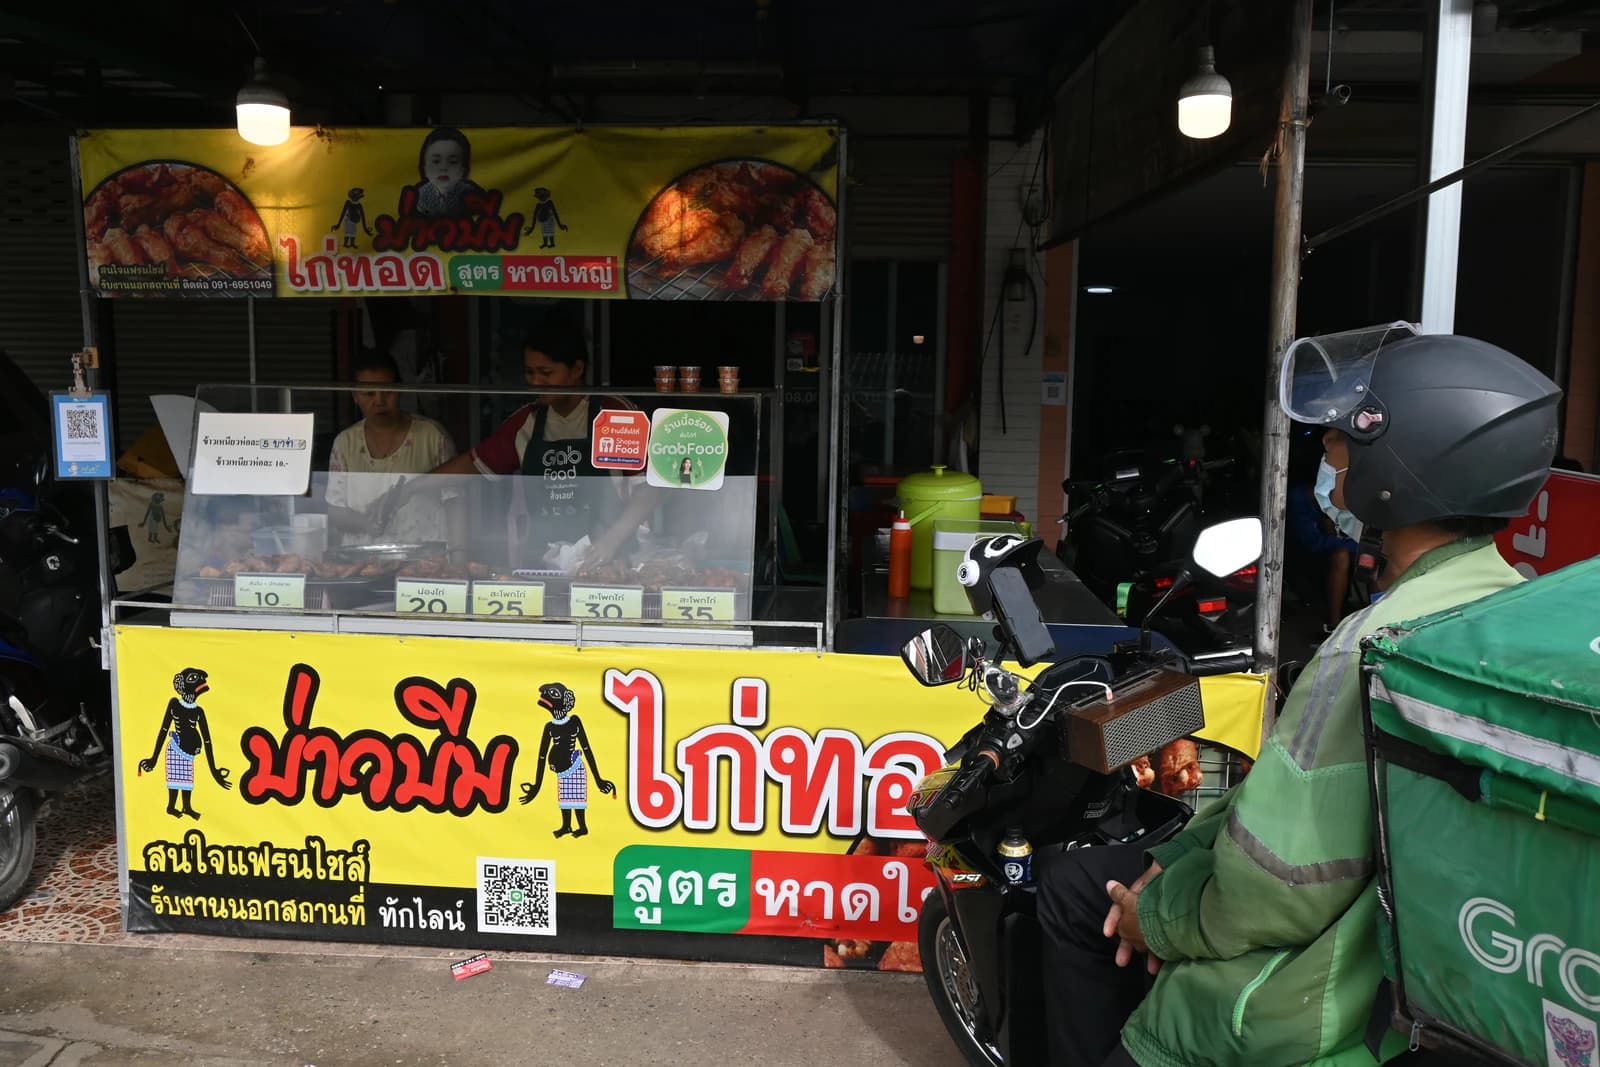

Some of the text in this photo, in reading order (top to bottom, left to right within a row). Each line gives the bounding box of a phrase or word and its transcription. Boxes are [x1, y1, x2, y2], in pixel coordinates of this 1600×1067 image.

[279, 235, 446, 291] ไก่ทอด
[456, 256, 614, 290] สูตร หาดใหญ่
[100, 278, 272, 290] รับงานนอกสถานที่ ติดต่อ 091-6951049
[663, 414, 713, 434] ร้านนี้อร่อย
[262, 439, 269, 448] 5
[615, 437, 640, 447] Shopee
[615, 445, 640, 454] Food
[651, 442, 725, 455] GrabFood
[543, 465, 577, 481] Food
[254, 591, 280, 606] 10
[417, 587, 445, 596] น่องไก่
[490, 589, 526, 599] สะโพกไก่
[588, 592, 624, 602] สะโพกไก่
[408, 597, 448, 614] 20
[679, 595, 716, 605] สะโพกไก่
[487, 600, 524, 616] 25
[584, 602, 623, 618] 30
[677, 606, 714, 620] 35
[146, 833, 367, 884] สนใจแฟรนไชส์
[624, 861, 936, 926] สูตร หาดใ
[150, 885, 466, 932] รับงานนอกสถานที่ ทักไลน์
